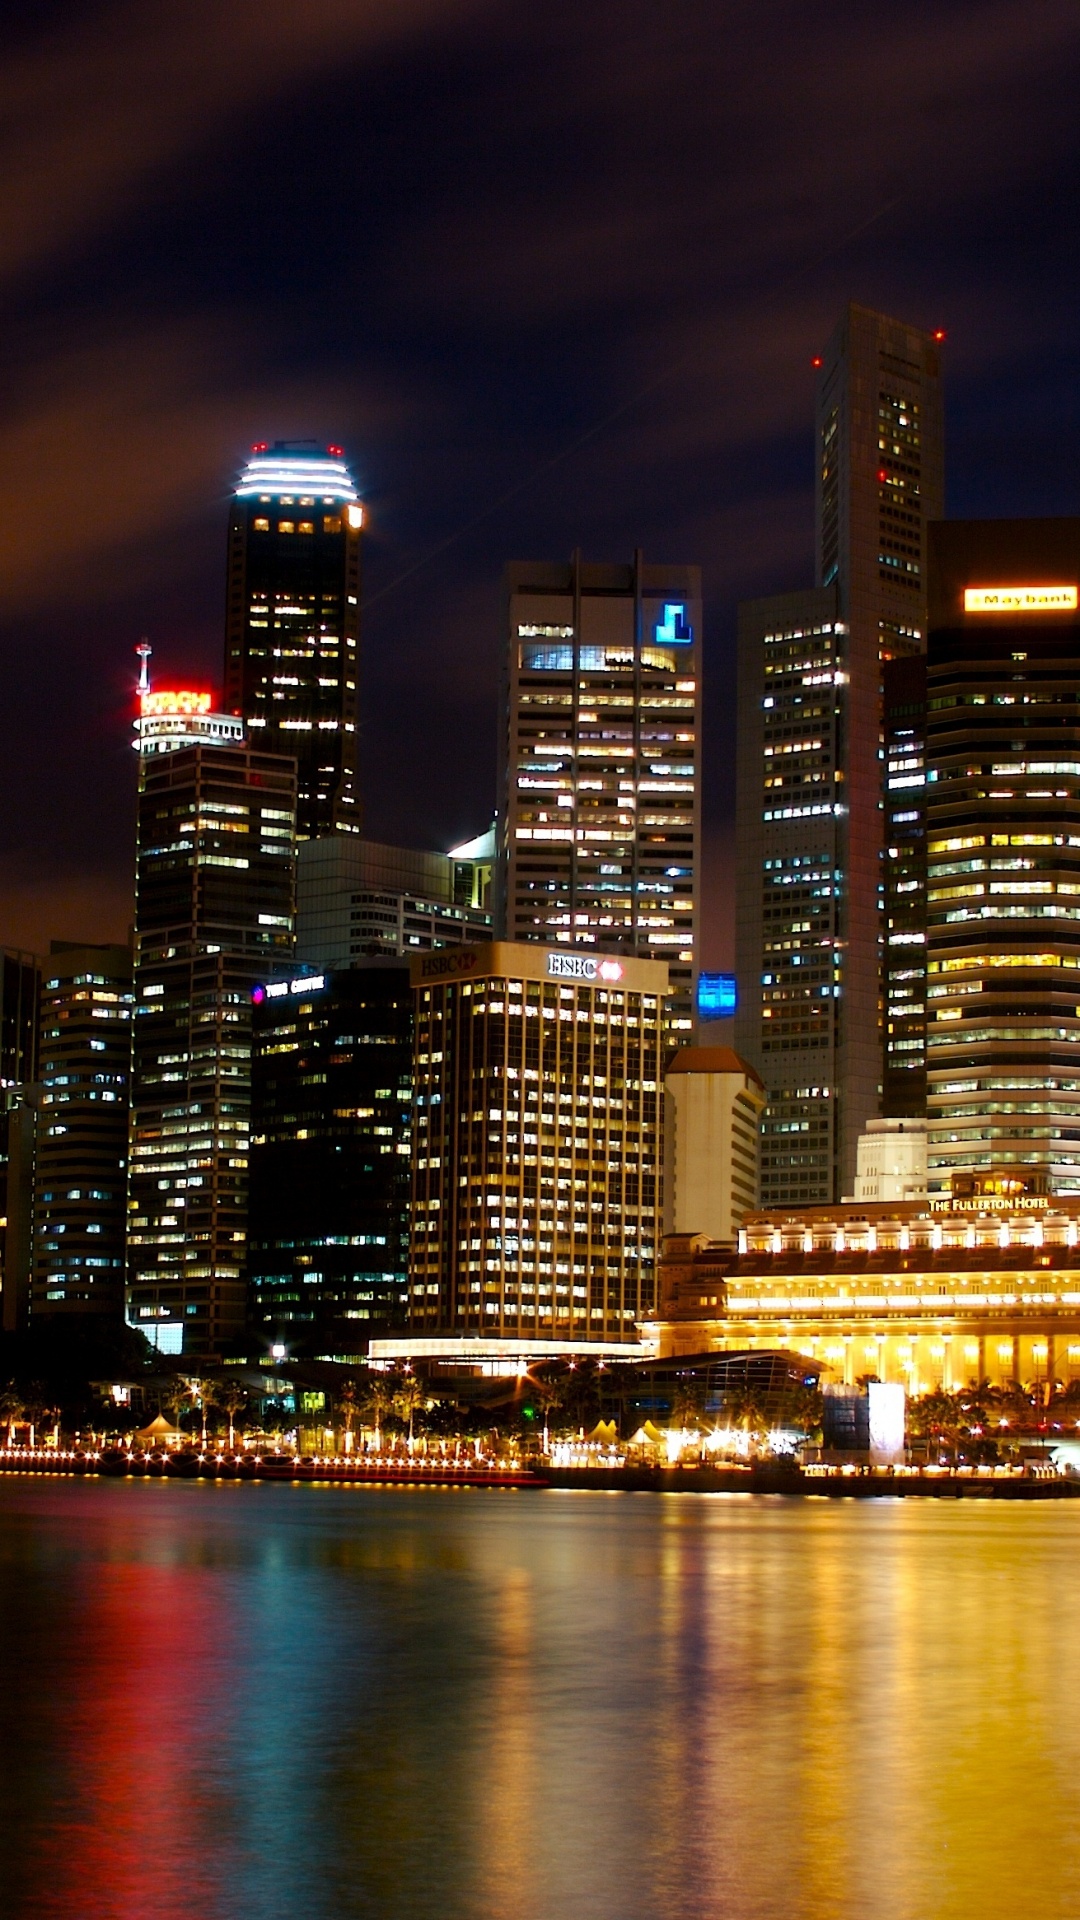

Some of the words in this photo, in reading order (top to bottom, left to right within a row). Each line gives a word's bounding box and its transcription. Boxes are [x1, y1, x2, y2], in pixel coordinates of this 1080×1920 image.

[984, 594, 1071, 606] Maybank
[421, 955, 457, 977] HSBC
[548, 953, 597, 979] HSBC
[929, 1200, 950, 1212] THE
[952, 1198, 1013, 1212] FULLERTON
[1015, 1196, 1050, 1209] HOTEL
